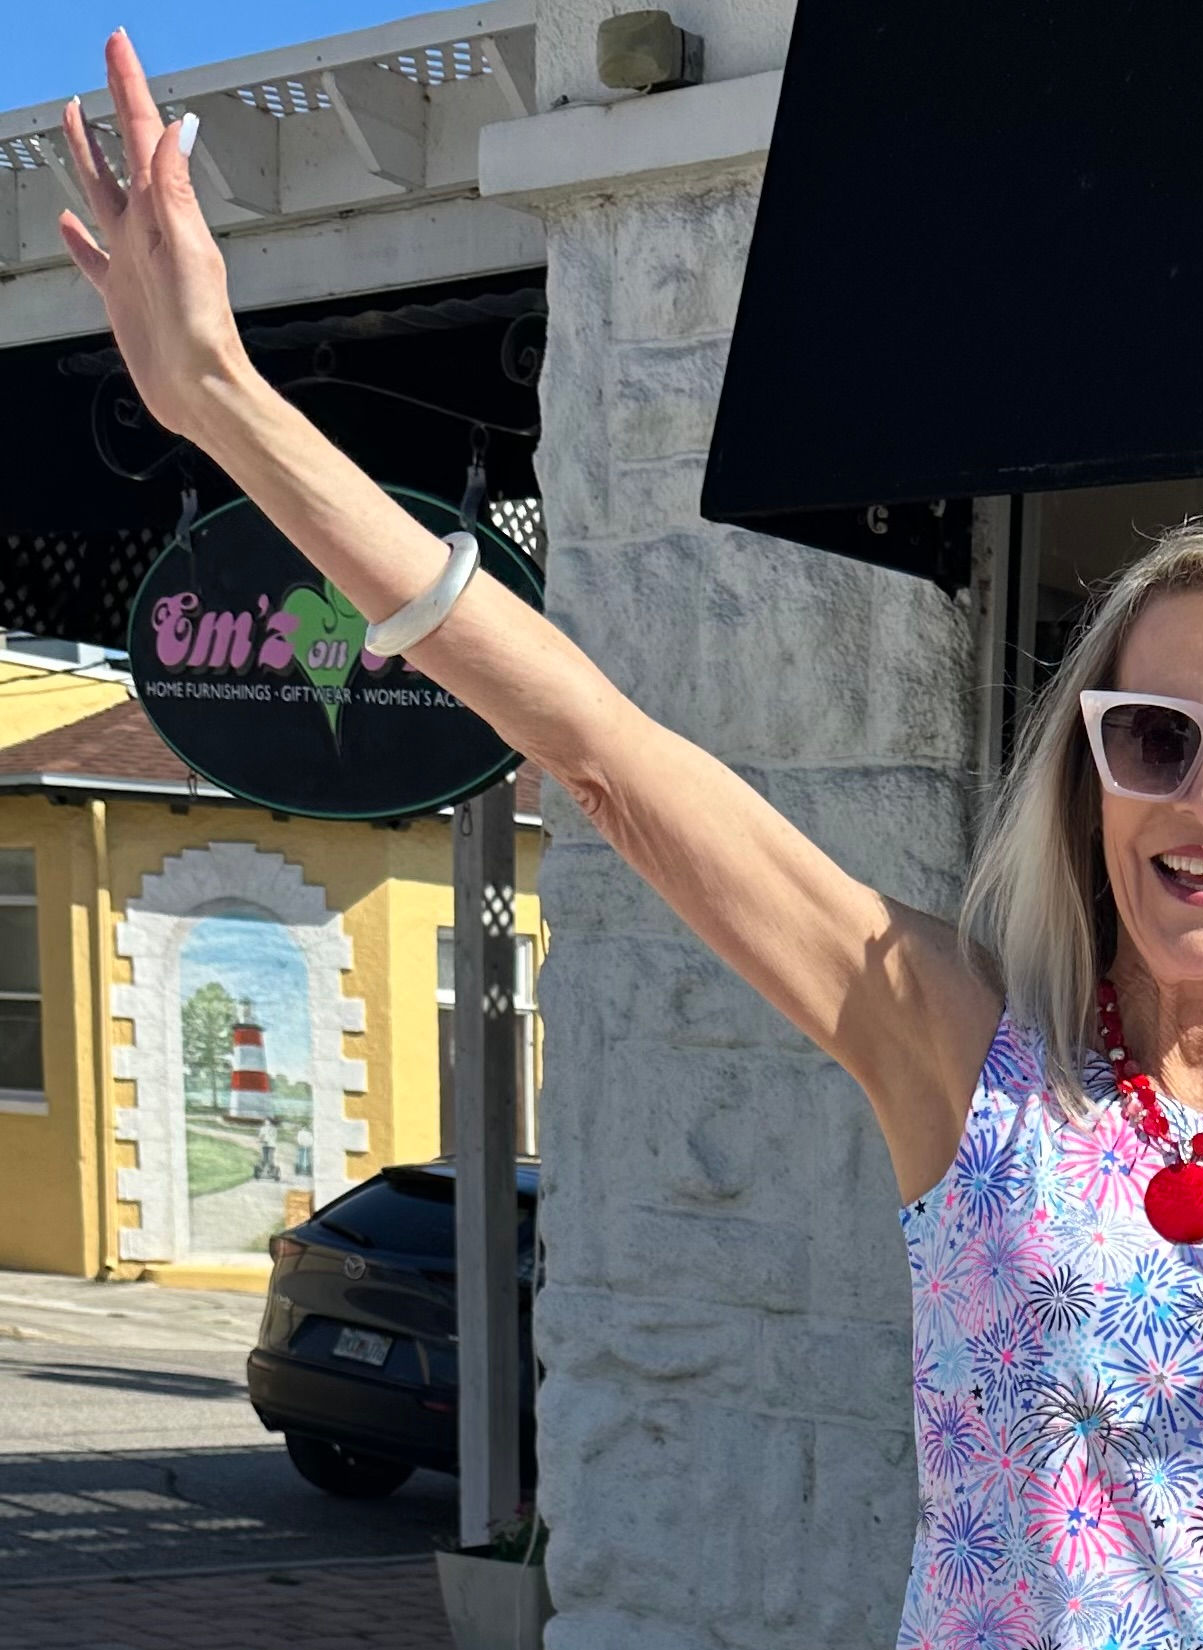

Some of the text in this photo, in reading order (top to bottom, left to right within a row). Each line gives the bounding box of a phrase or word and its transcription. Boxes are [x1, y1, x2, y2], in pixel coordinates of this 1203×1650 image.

[308, 640, 347, 669] on
[146, 681, 184, 697] HOME
[186, 682, 271, 701] FURNISHINGS
[281, 685, 352, 705] GIFTWEAR
[362, 687, 432, 707] WOMEN'S
